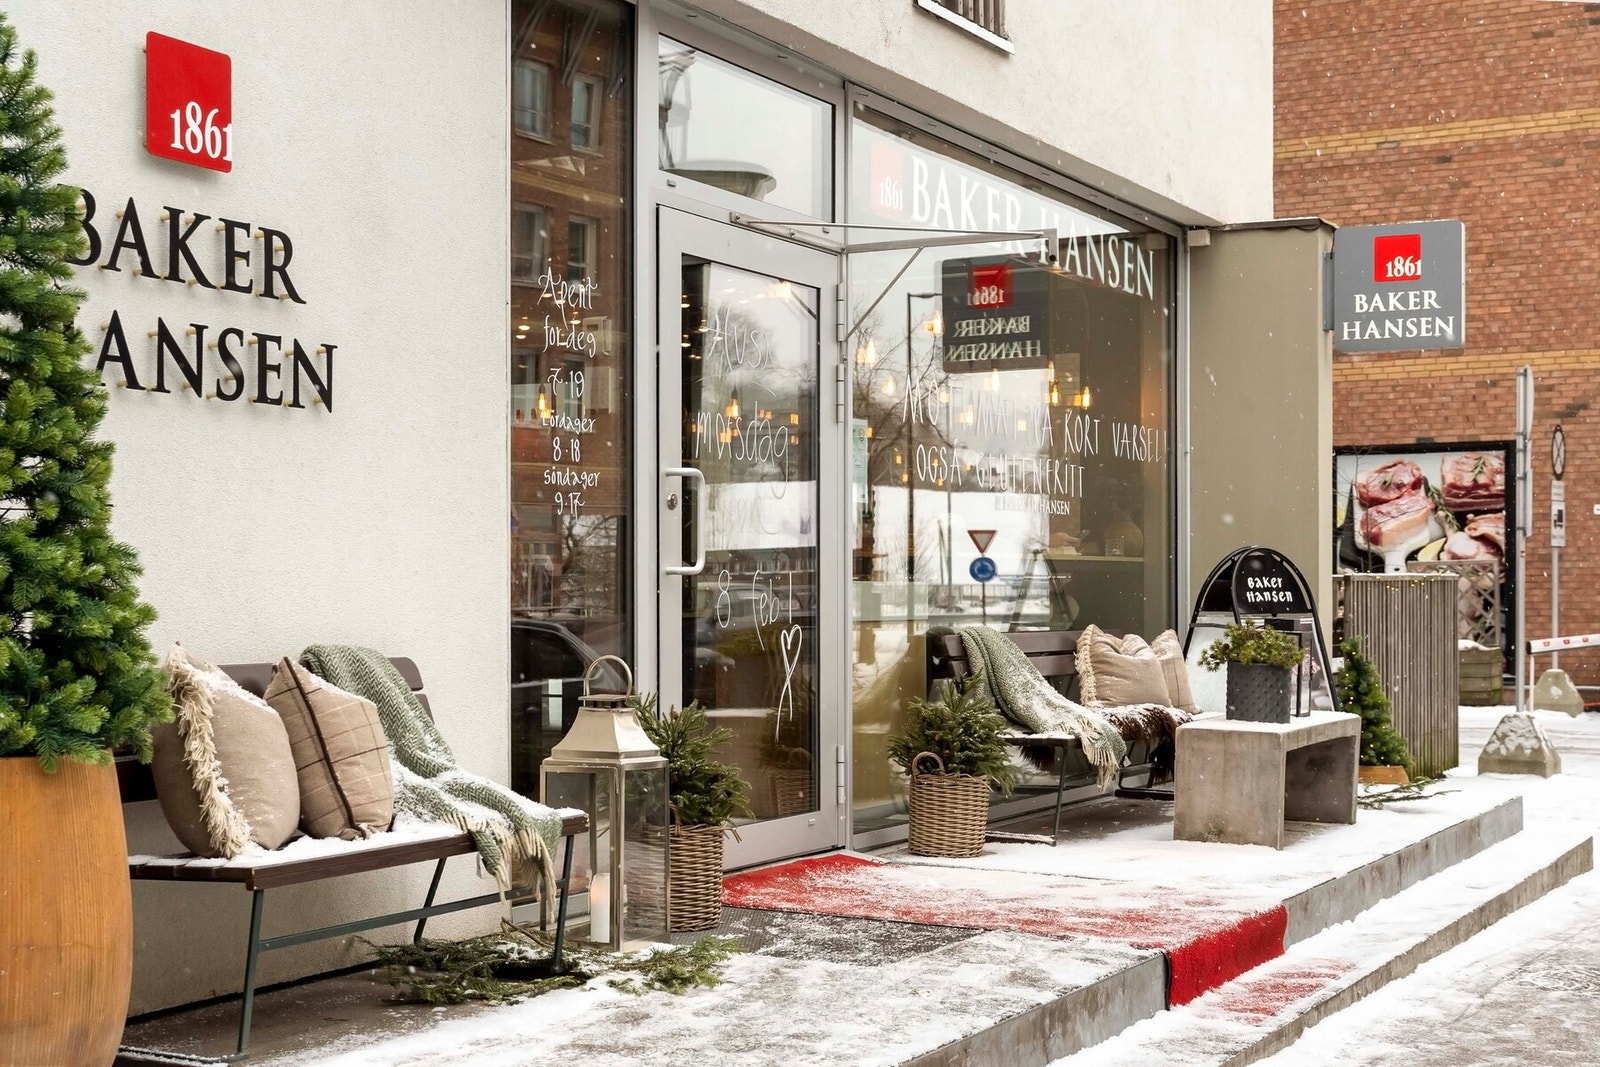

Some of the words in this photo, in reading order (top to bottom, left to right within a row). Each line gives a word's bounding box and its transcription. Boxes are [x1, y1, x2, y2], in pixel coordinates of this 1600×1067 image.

[170, 101, 232, 162] 1861
[880, 176, 903, 212] 1861
[911, 155, 1028, 258] BAKER
[1039, 206, 1154, 301] HANSEN
[1386, 256, 1421, 278] 1861
[1354, 290, 1442, 313] BAKER
[565, 320, 596, 358] deg
[1341, 316, 1455, 341] HANSEN
[68, 309, 338, 414] ANSEN
[1064, 410, 1101, 458] KORT
[1246, 589, 1294, 603] Hansen
[1247, 576, 1283, 589] Baker
